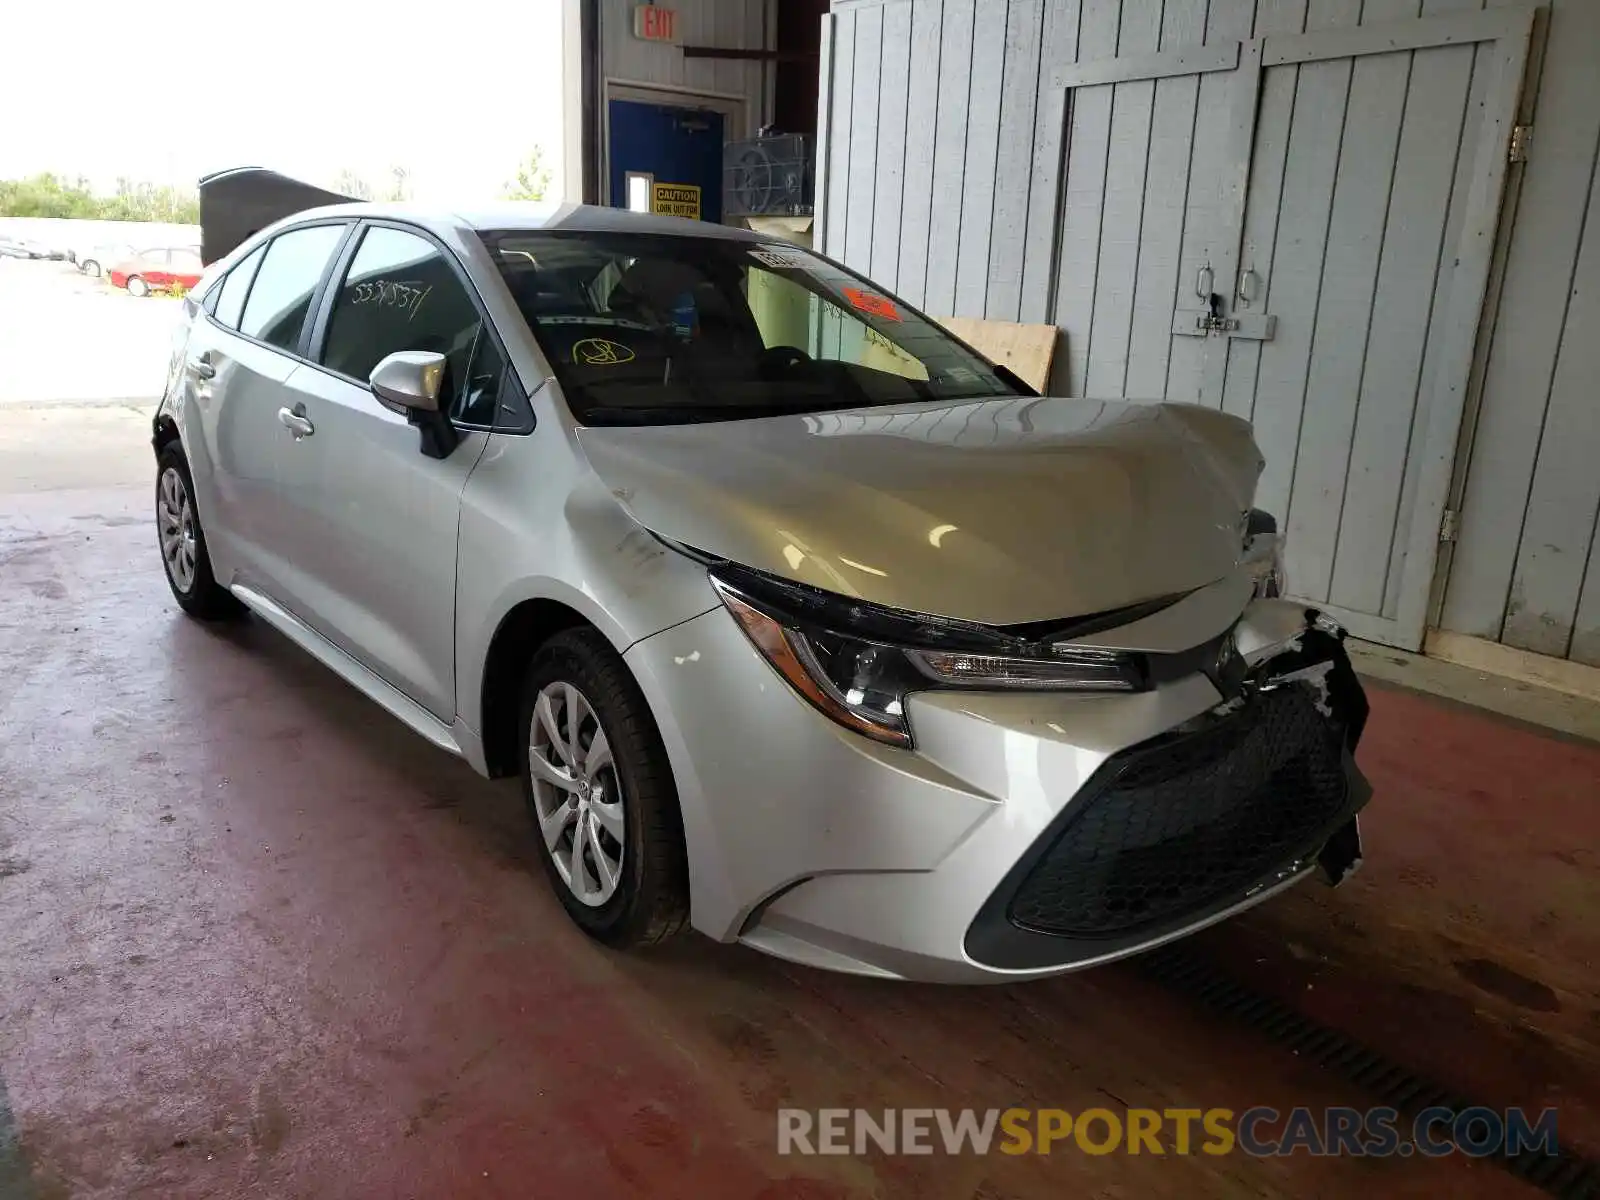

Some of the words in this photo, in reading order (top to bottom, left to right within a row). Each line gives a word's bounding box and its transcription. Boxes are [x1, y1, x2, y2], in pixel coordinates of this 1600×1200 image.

[644, 7, 677, 40] EXIT
[658, 189, 697, 201] CAUTION
[656, 203, 672, 213] LOOK
[673, 204, 686, 214] OUT
[686, 206, 698, 214] FOR
